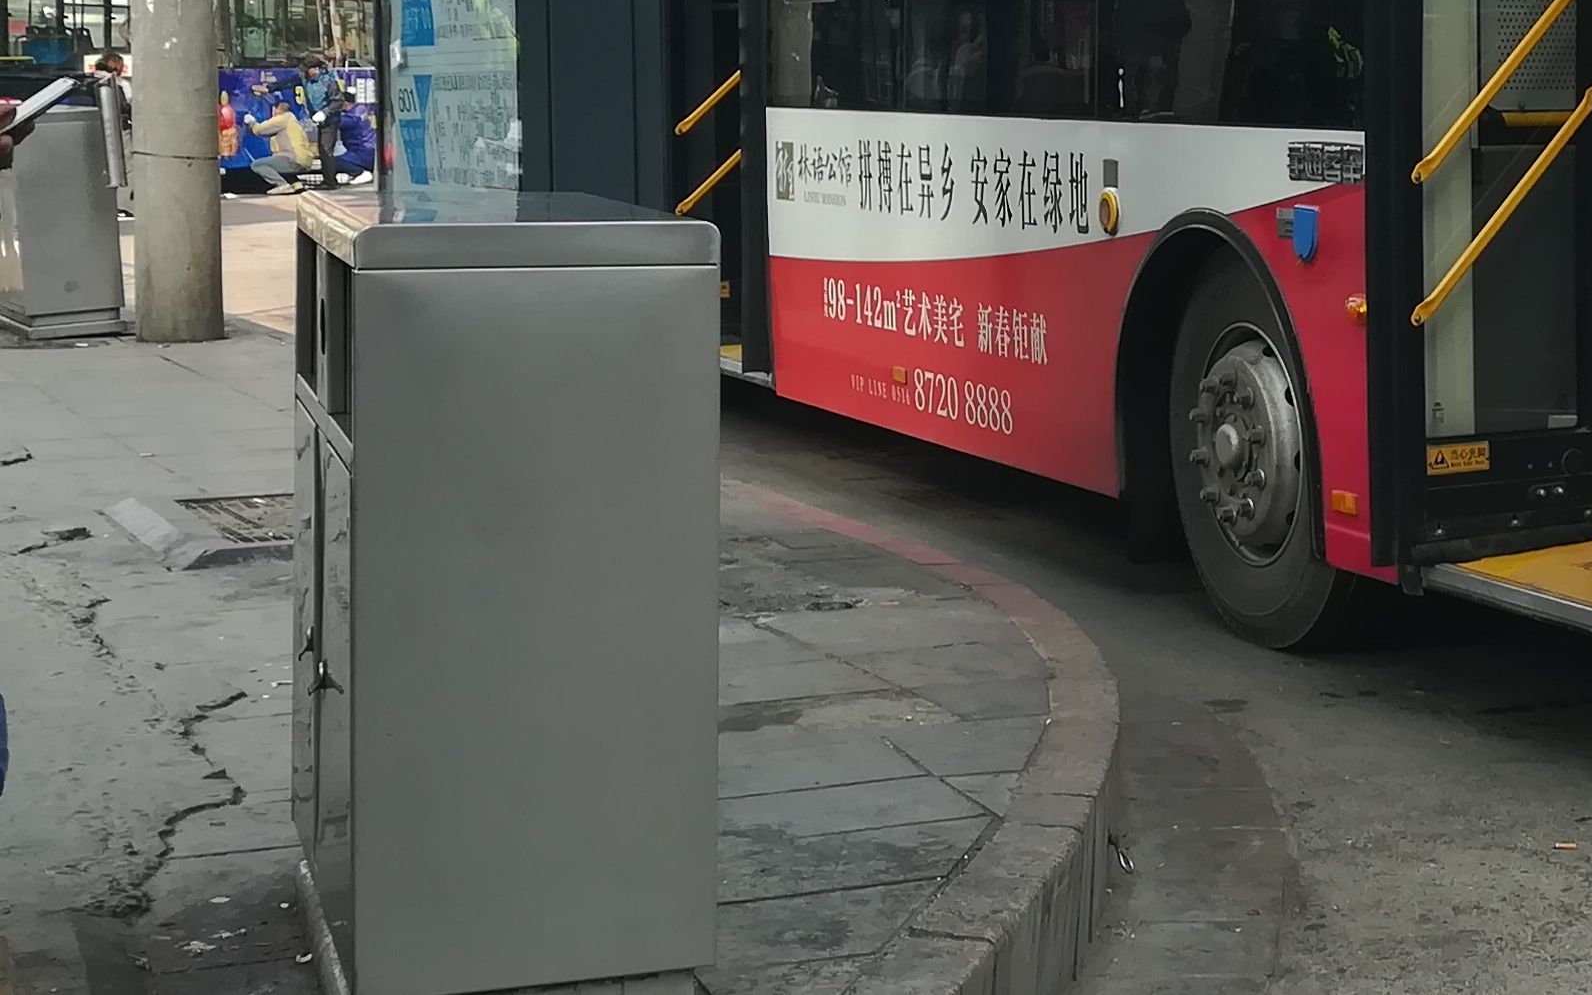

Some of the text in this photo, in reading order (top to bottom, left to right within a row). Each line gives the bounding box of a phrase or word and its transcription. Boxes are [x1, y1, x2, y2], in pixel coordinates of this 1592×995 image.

[398, 88, 418, 113] 601
[797, 142, 853, 188] 林语公馆
[857, 139, 955, 222] 拼搏在异乡
[970, 145, 1090, 235] 安家在绿地
[977, 302, 1049, 366] 新春钜献
[851, 373, 865, 392] VIP
[868, 379, 888, 400] LINE
[914, 368, 960, 421] 8720
[964, 380, 1014, 435] 8888
